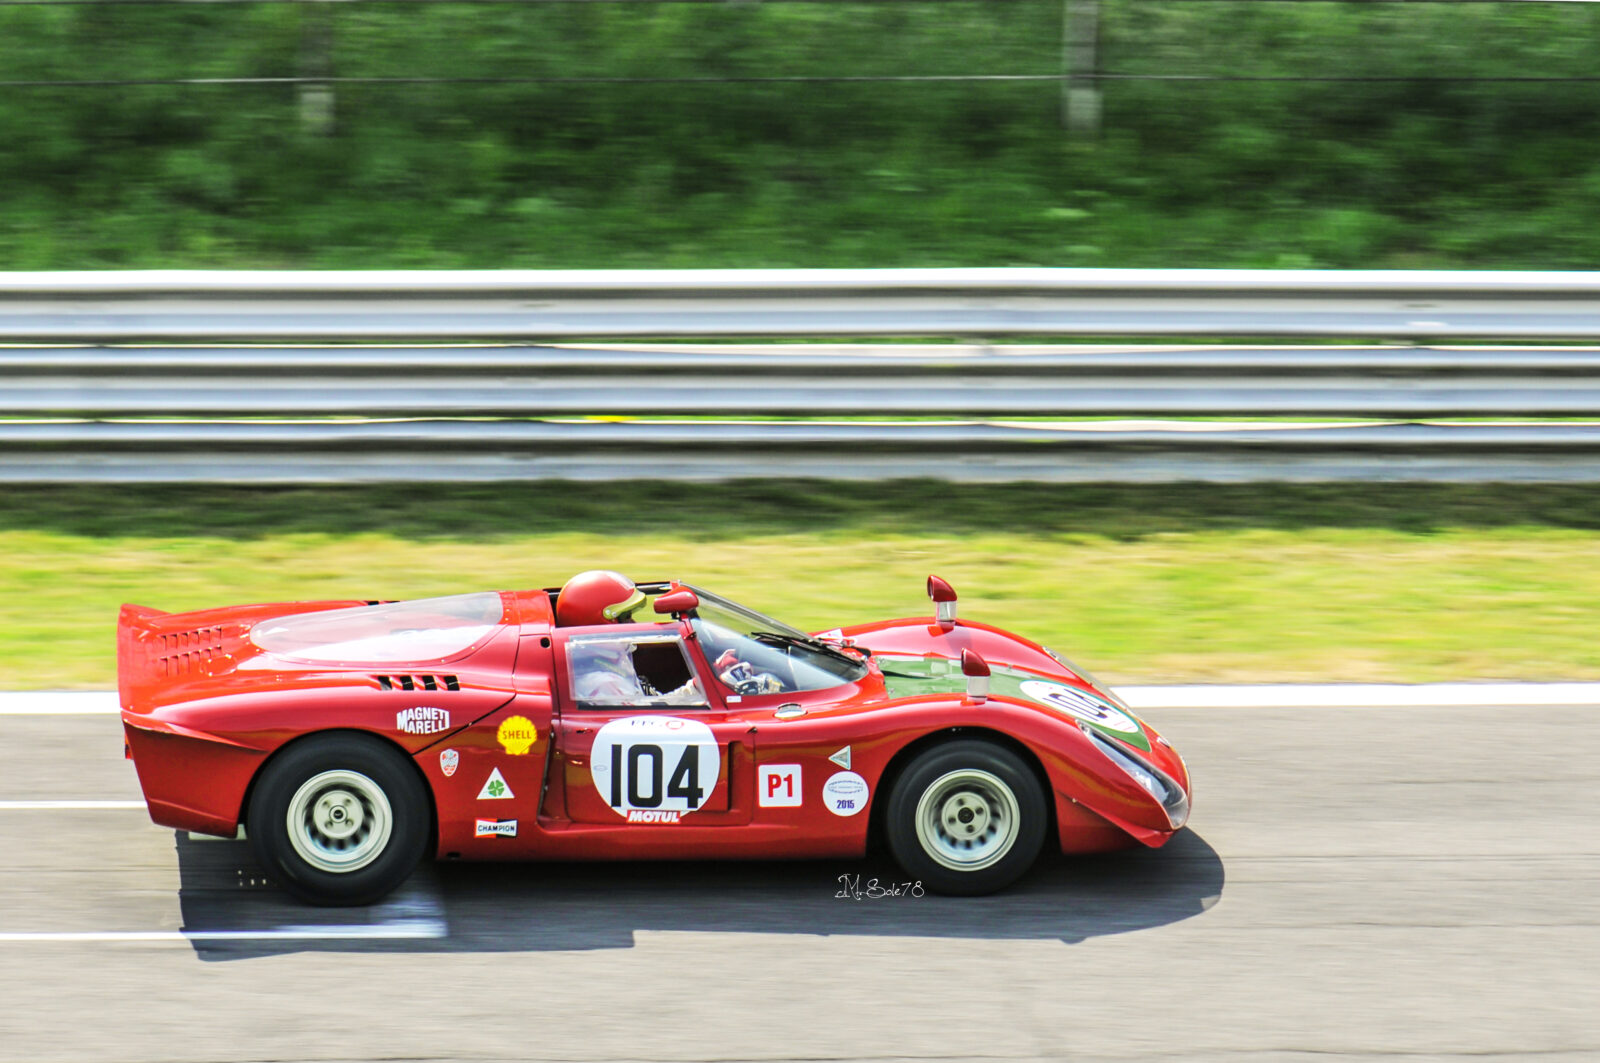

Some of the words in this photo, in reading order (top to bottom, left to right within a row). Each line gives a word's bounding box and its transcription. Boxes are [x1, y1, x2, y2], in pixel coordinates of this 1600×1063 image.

[397, 706, 450, 722] MAGNETI
[397, 718, 450, 735] MARELLI
[502, 730, 532, 739] SHELL
[611, 744, 704, 809] 104
[767, 774, 794, 798] P1
[836, 799, 855, 809] 2015
[628, 811, 680, 823] MOTUL
